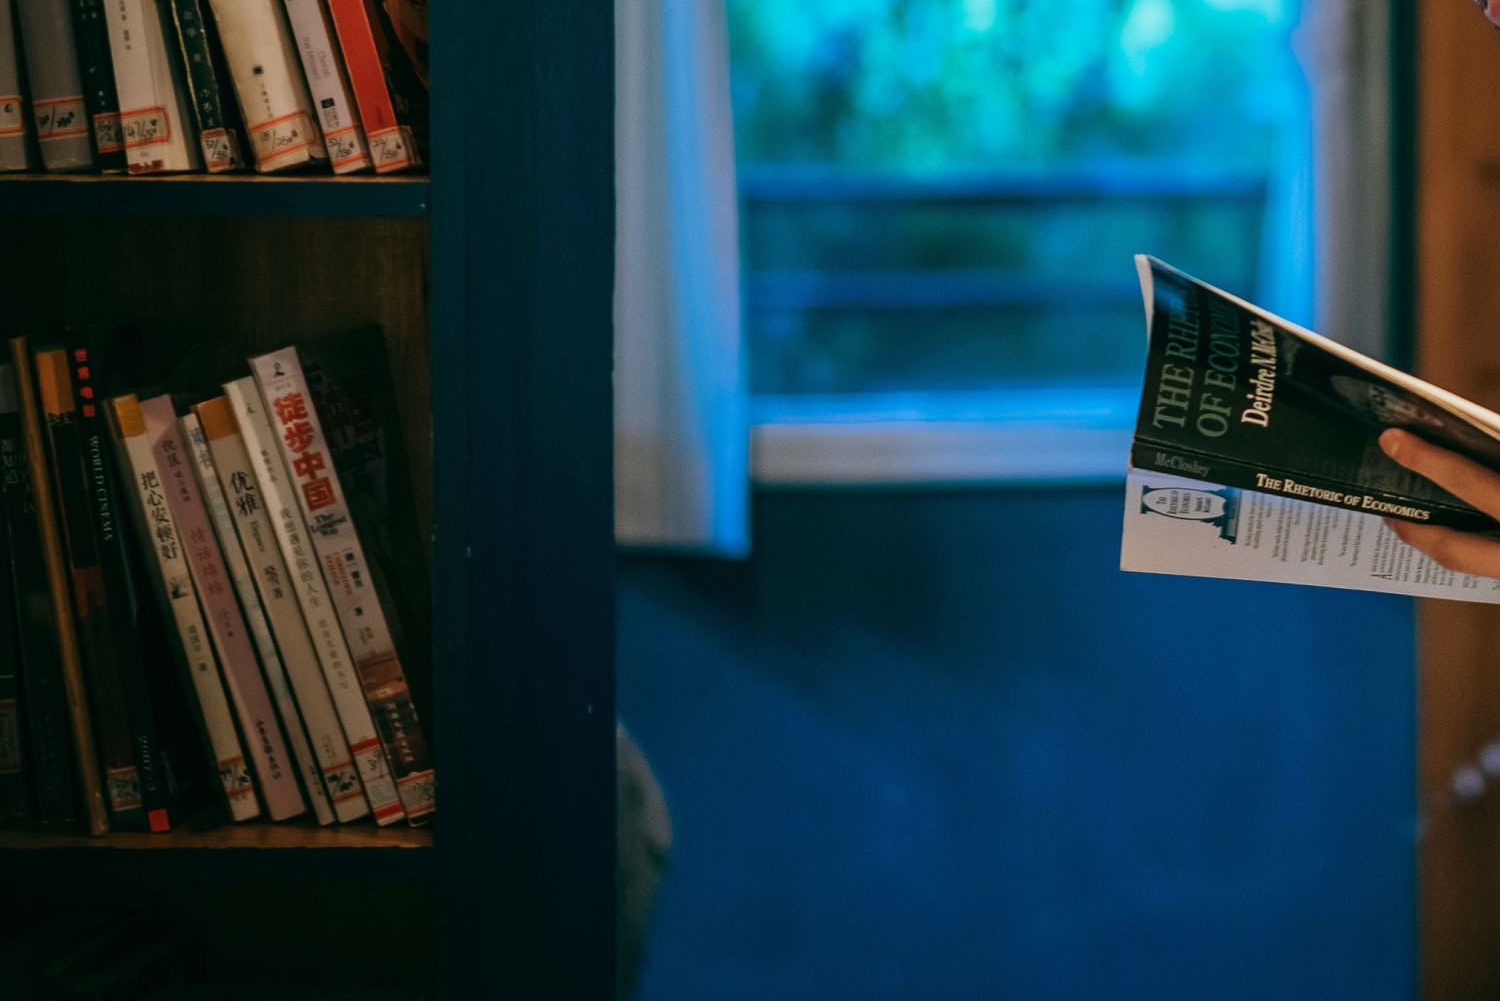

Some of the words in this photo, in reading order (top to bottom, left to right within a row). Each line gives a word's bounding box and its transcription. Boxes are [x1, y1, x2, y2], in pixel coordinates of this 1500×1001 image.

[1152, 363, 1195, 429] THE
[1196, 392, 1232, 438] OF
[1241, 367, 1276, 428] Deirdre
[273, 391, 337, 512] 徒步中国
[88, 435, 104, 485] WORLD
[96, 488, 114, 542] CINEMA
[230, 471, 259, 517] 优雅
[1256, 472, 1282, 490] THE
[1283, 477, 1342, 503] RHETORIC
[1344, 493, 1362, 507] OF
[1362, 495, 1431, 521] ECONOMICS
